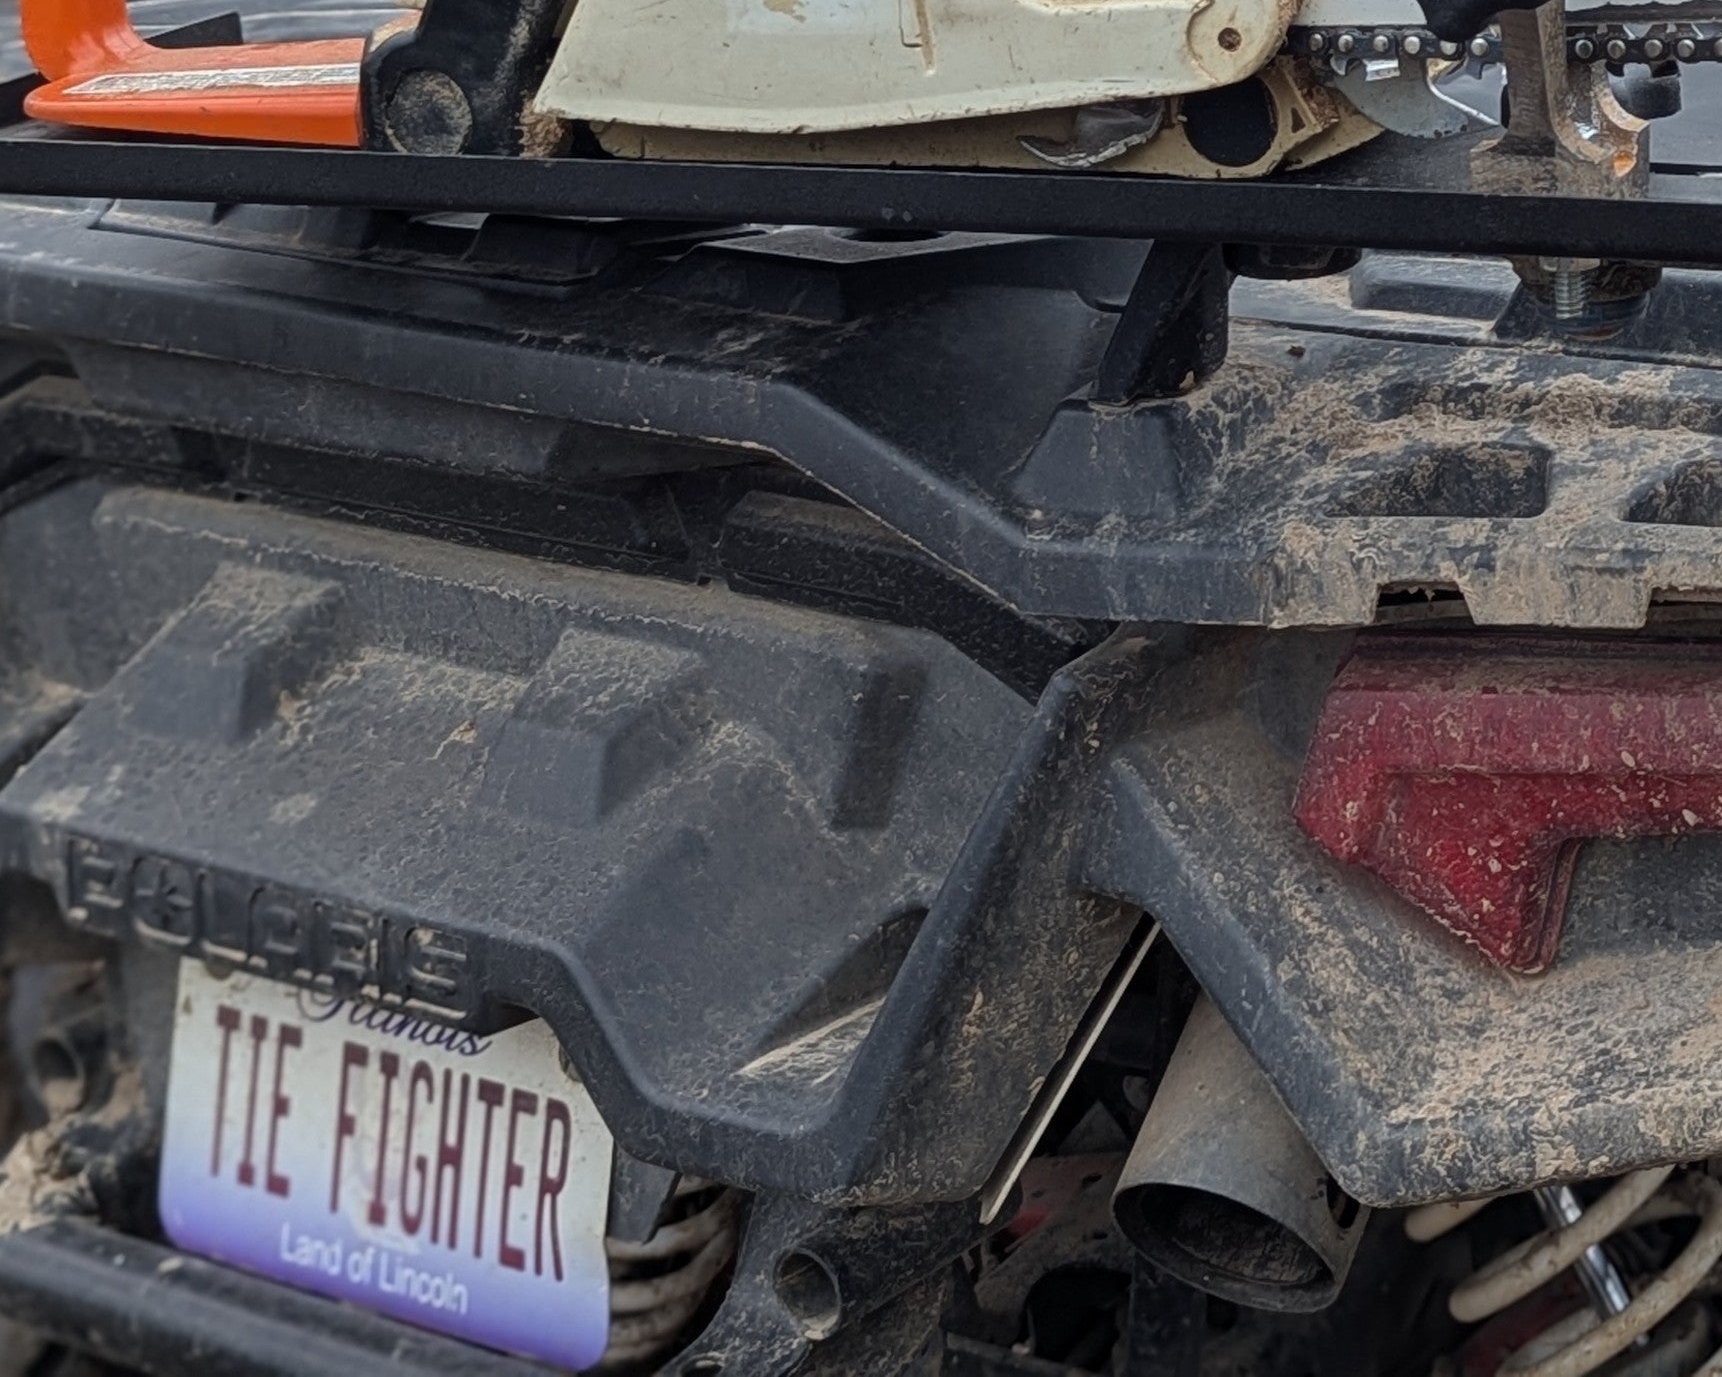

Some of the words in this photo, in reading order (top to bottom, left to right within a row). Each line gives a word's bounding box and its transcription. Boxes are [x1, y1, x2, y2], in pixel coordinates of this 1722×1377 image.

[211, 1003, 303, 1200] TIE
[329, 1039, 572, 1283] FIGHTER
[280, 1221, 343, 1276] Land
[347, 1245, 376, 1285] of
[378, 1251, 468, 1315] Lincoln
